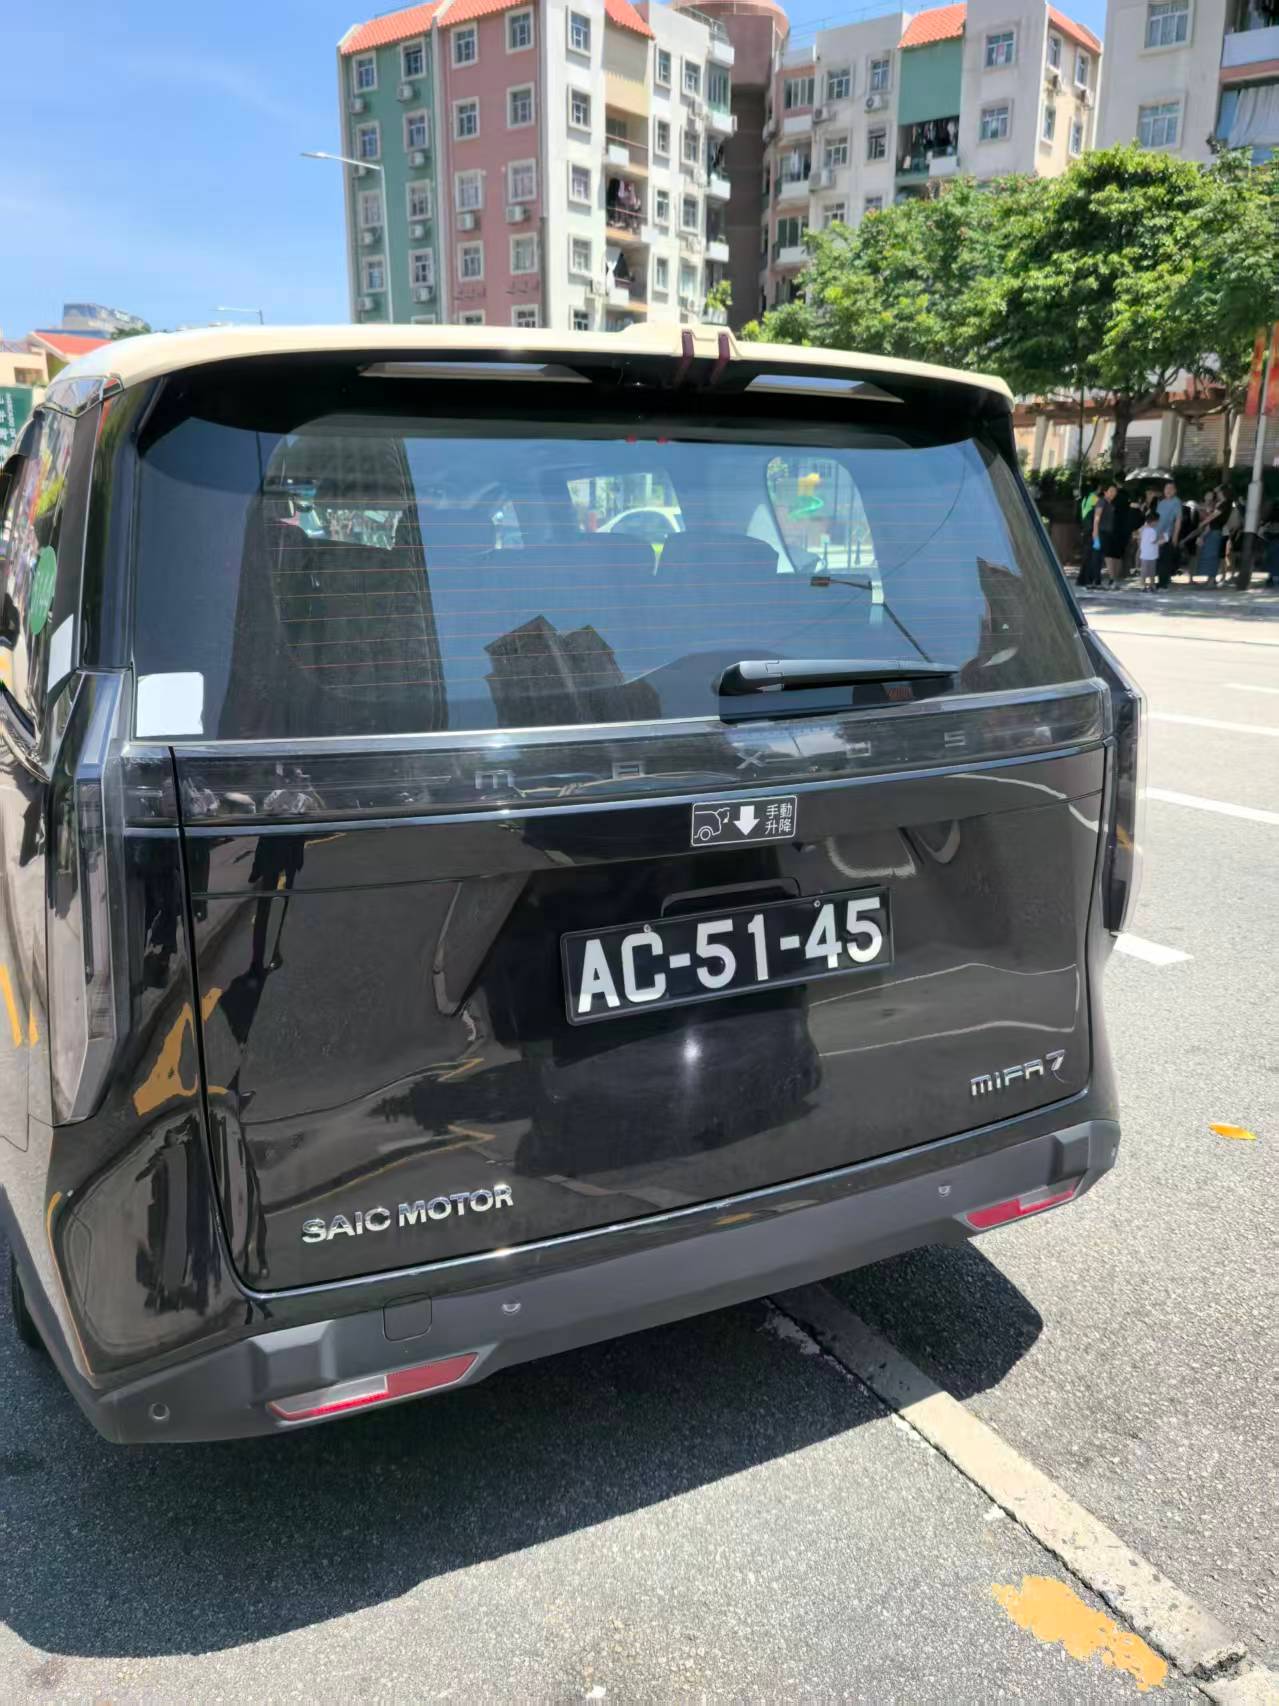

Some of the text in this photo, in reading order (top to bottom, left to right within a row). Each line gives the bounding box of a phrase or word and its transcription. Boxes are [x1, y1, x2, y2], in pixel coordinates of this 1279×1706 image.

[765, 803, 793, 819] 手動
[765, 818, 792, 835] 升降
[578, 896, 883, 1014] AC-51-45
[302, 1183, 514, 1243] SAIC MOTOR
